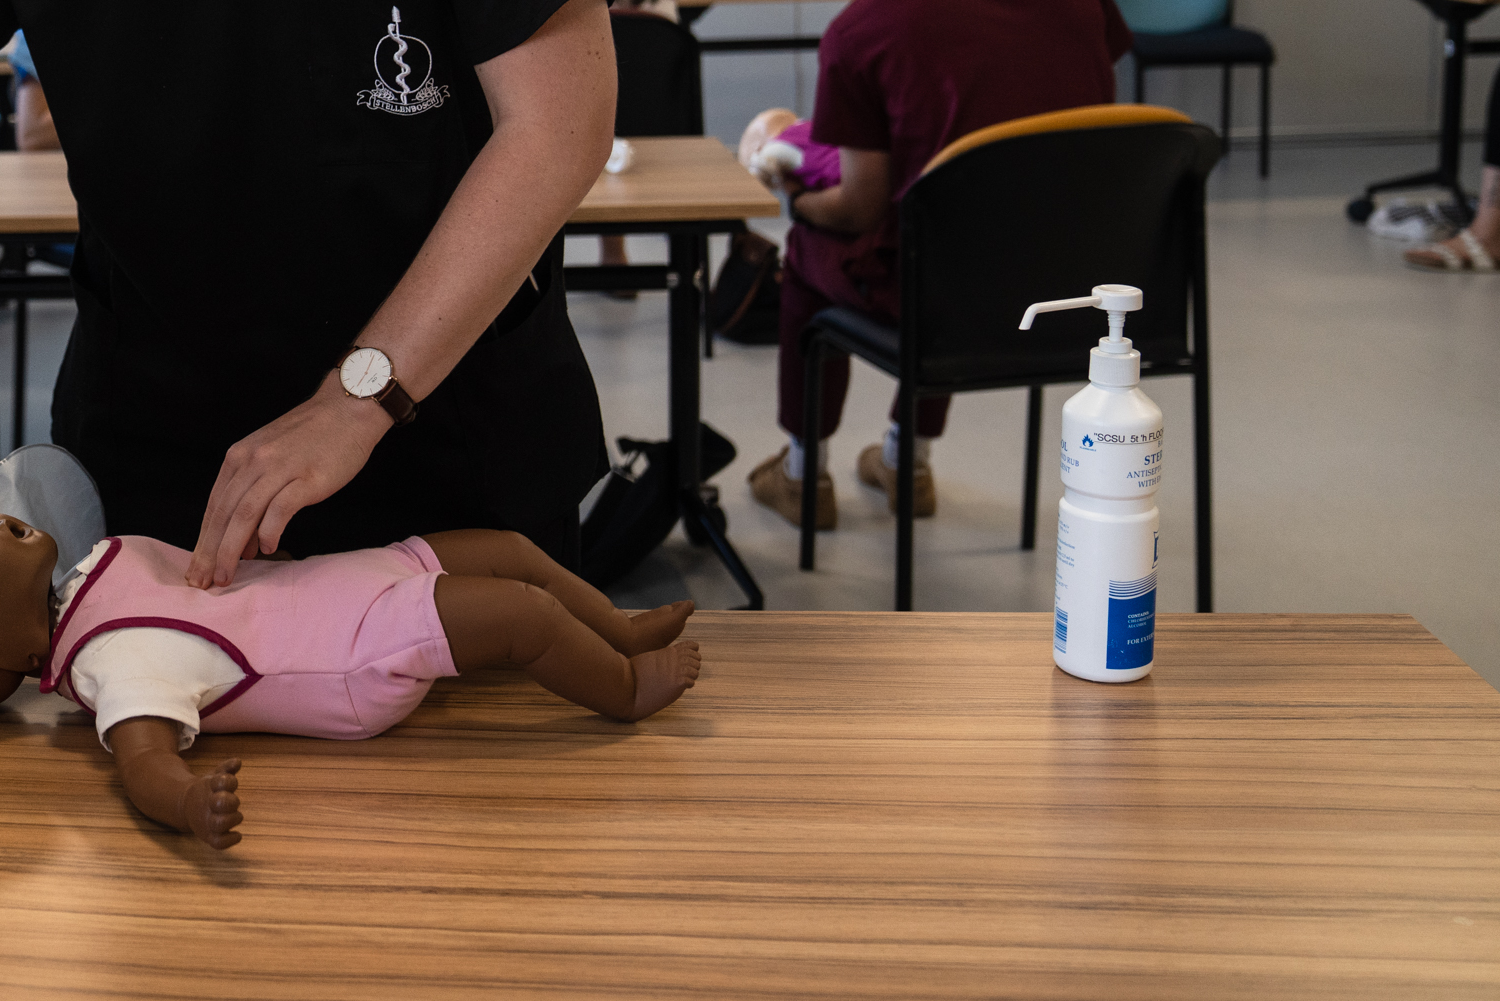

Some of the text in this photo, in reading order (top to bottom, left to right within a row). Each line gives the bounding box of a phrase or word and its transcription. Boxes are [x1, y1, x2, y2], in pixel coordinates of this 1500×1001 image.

[375, 96, 436, 113] STELLENBOSCH
[1148, 427, 1164, 441] FLOO
[1066, 456, 1080, 467] RUB
[1138, 477, 1156, 488] WITH
